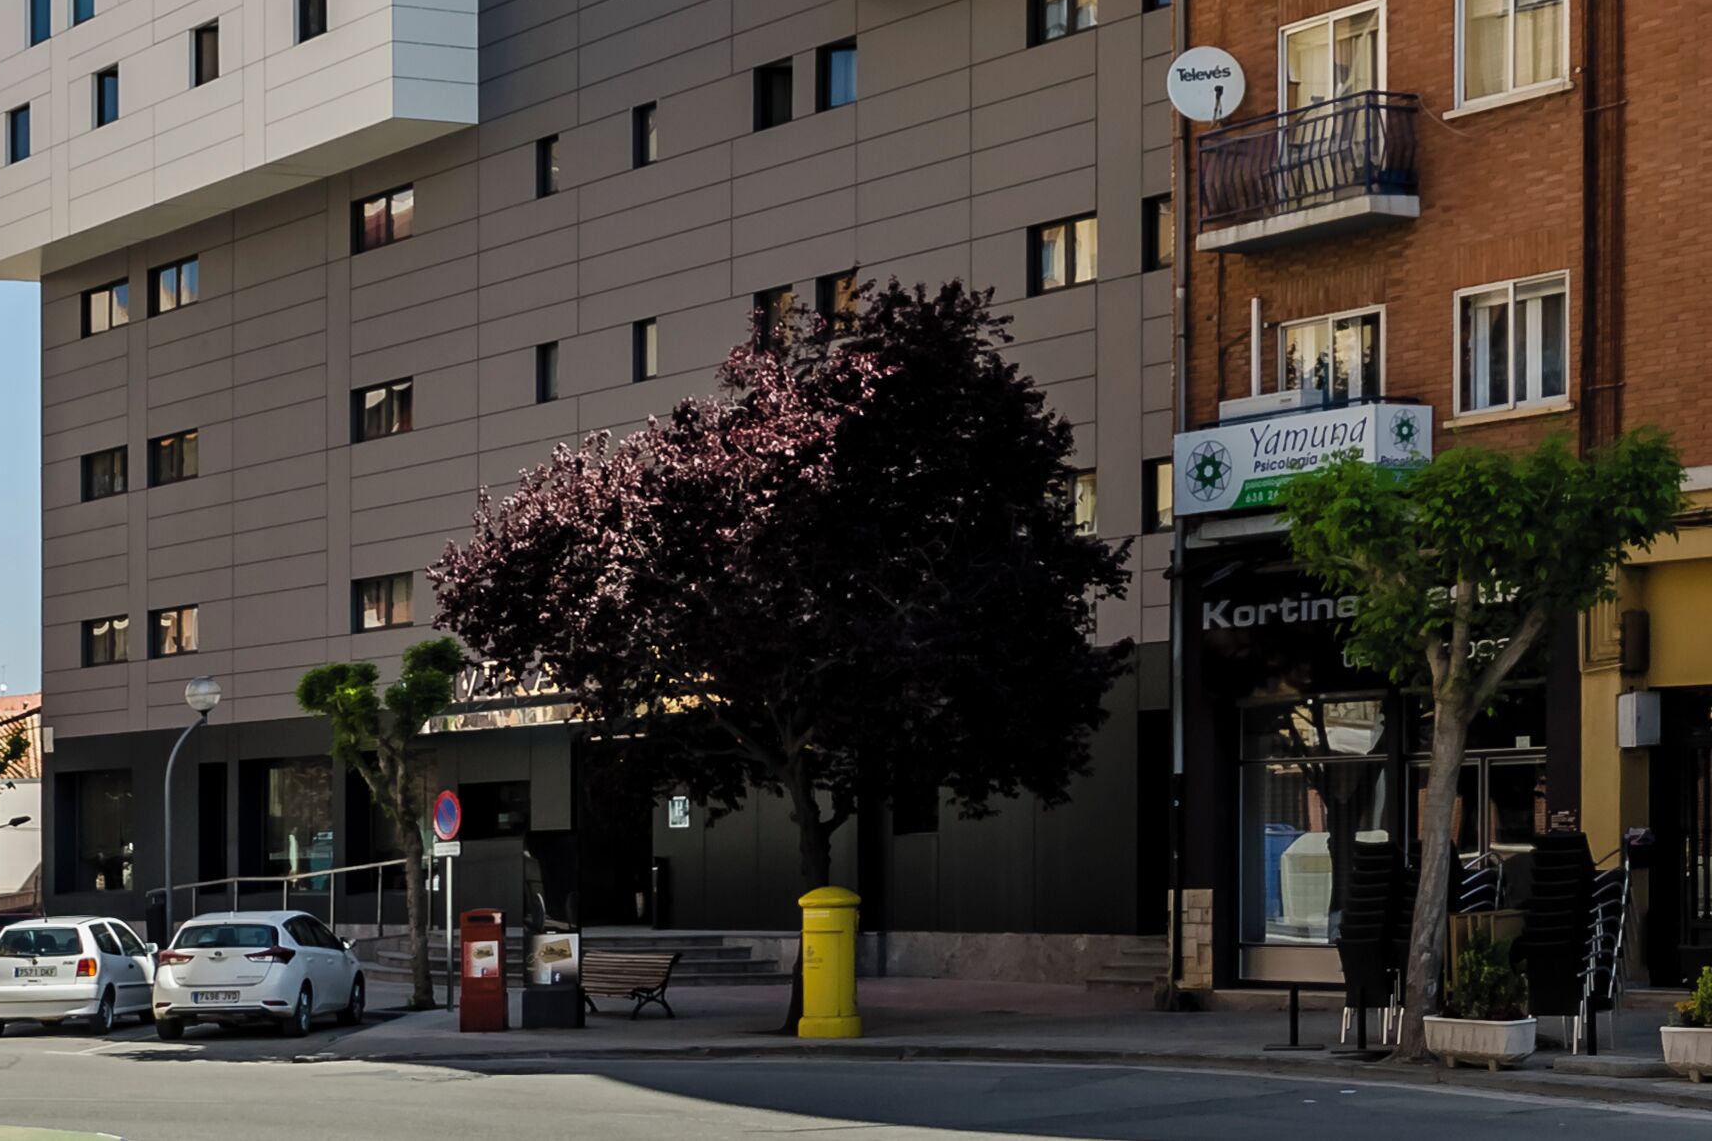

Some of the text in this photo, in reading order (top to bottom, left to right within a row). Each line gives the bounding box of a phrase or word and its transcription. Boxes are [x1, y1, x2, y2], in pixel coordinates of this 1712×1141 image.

[1176, 65, 1231, 82] Televés
[1249, 416, 1368, 458] Yamuna
[1253, 452, 1318, 473] Psicología
